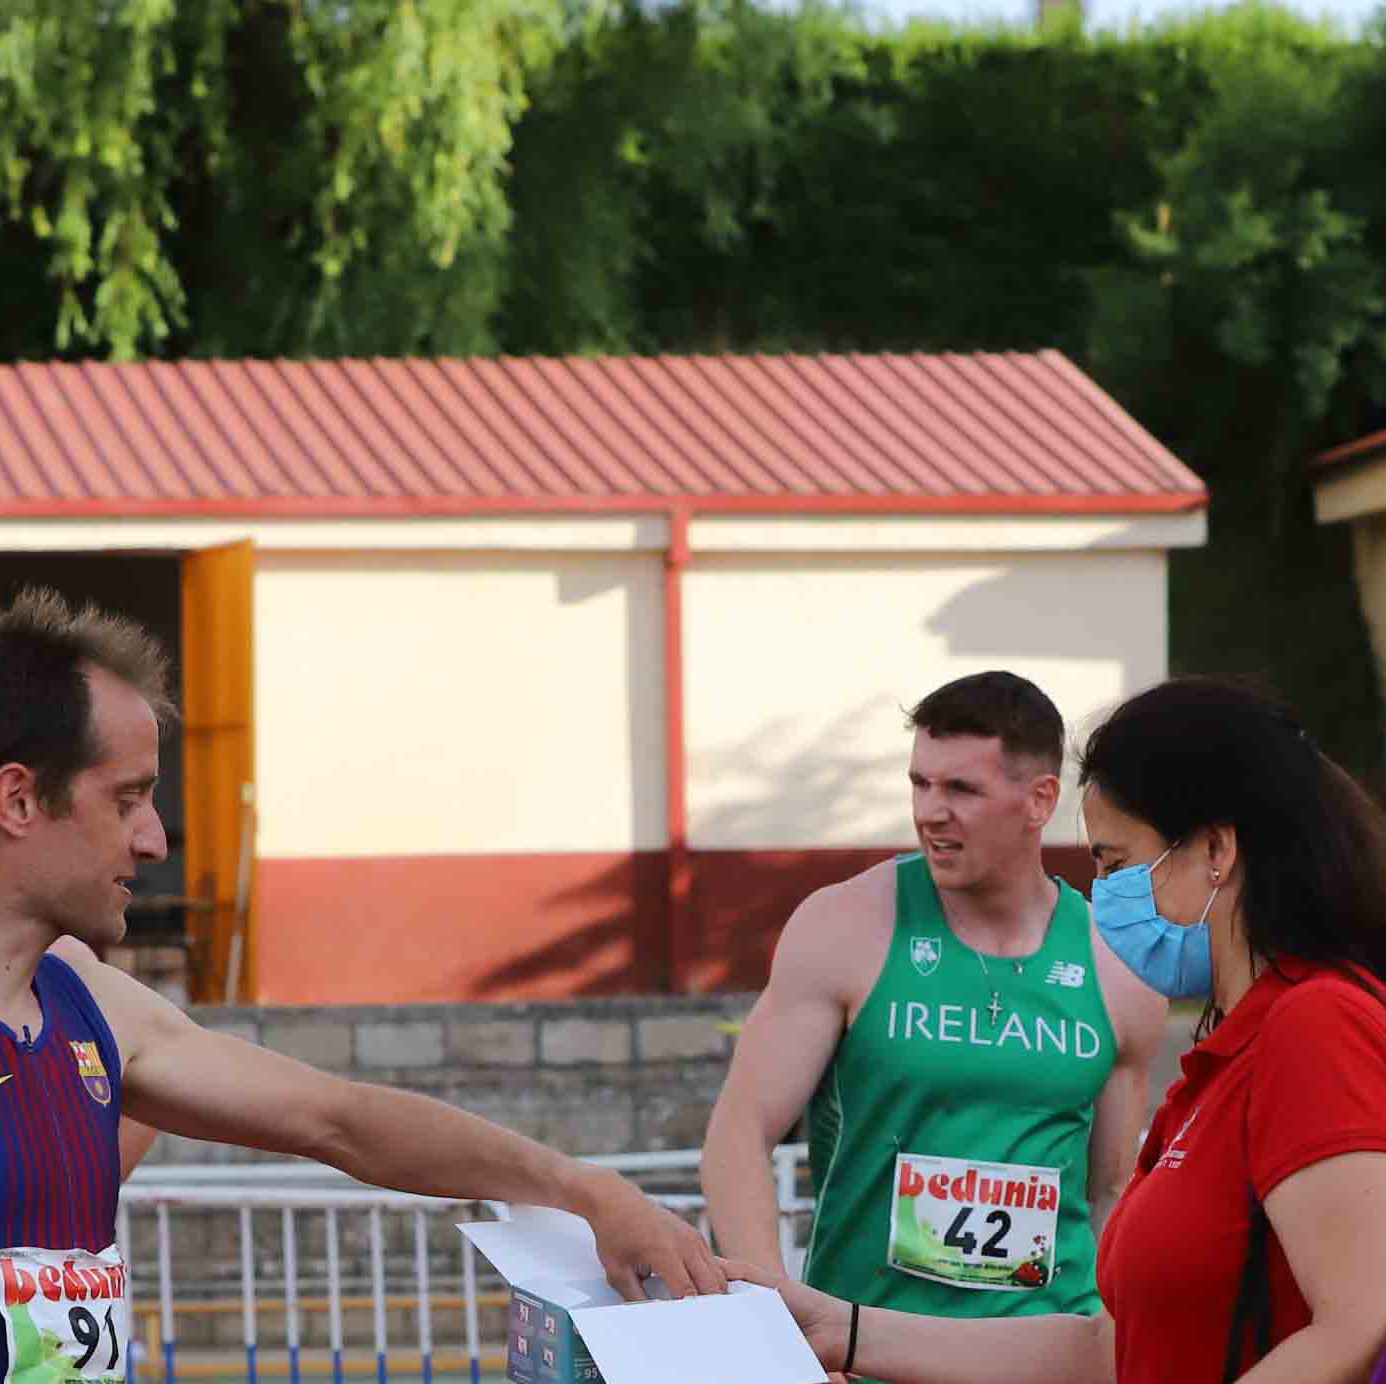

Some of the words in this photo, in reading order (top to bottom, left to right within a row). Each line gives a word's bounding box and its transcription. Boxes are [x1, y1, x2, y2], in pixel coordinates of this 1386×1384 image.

[887, 1000, 1101, 1060] IRELAND
[898, 1162, 1059, 1212] bedunia
[943, 1206, 1012, 1259] 42
[68, 1304, 120, 1371] 91
